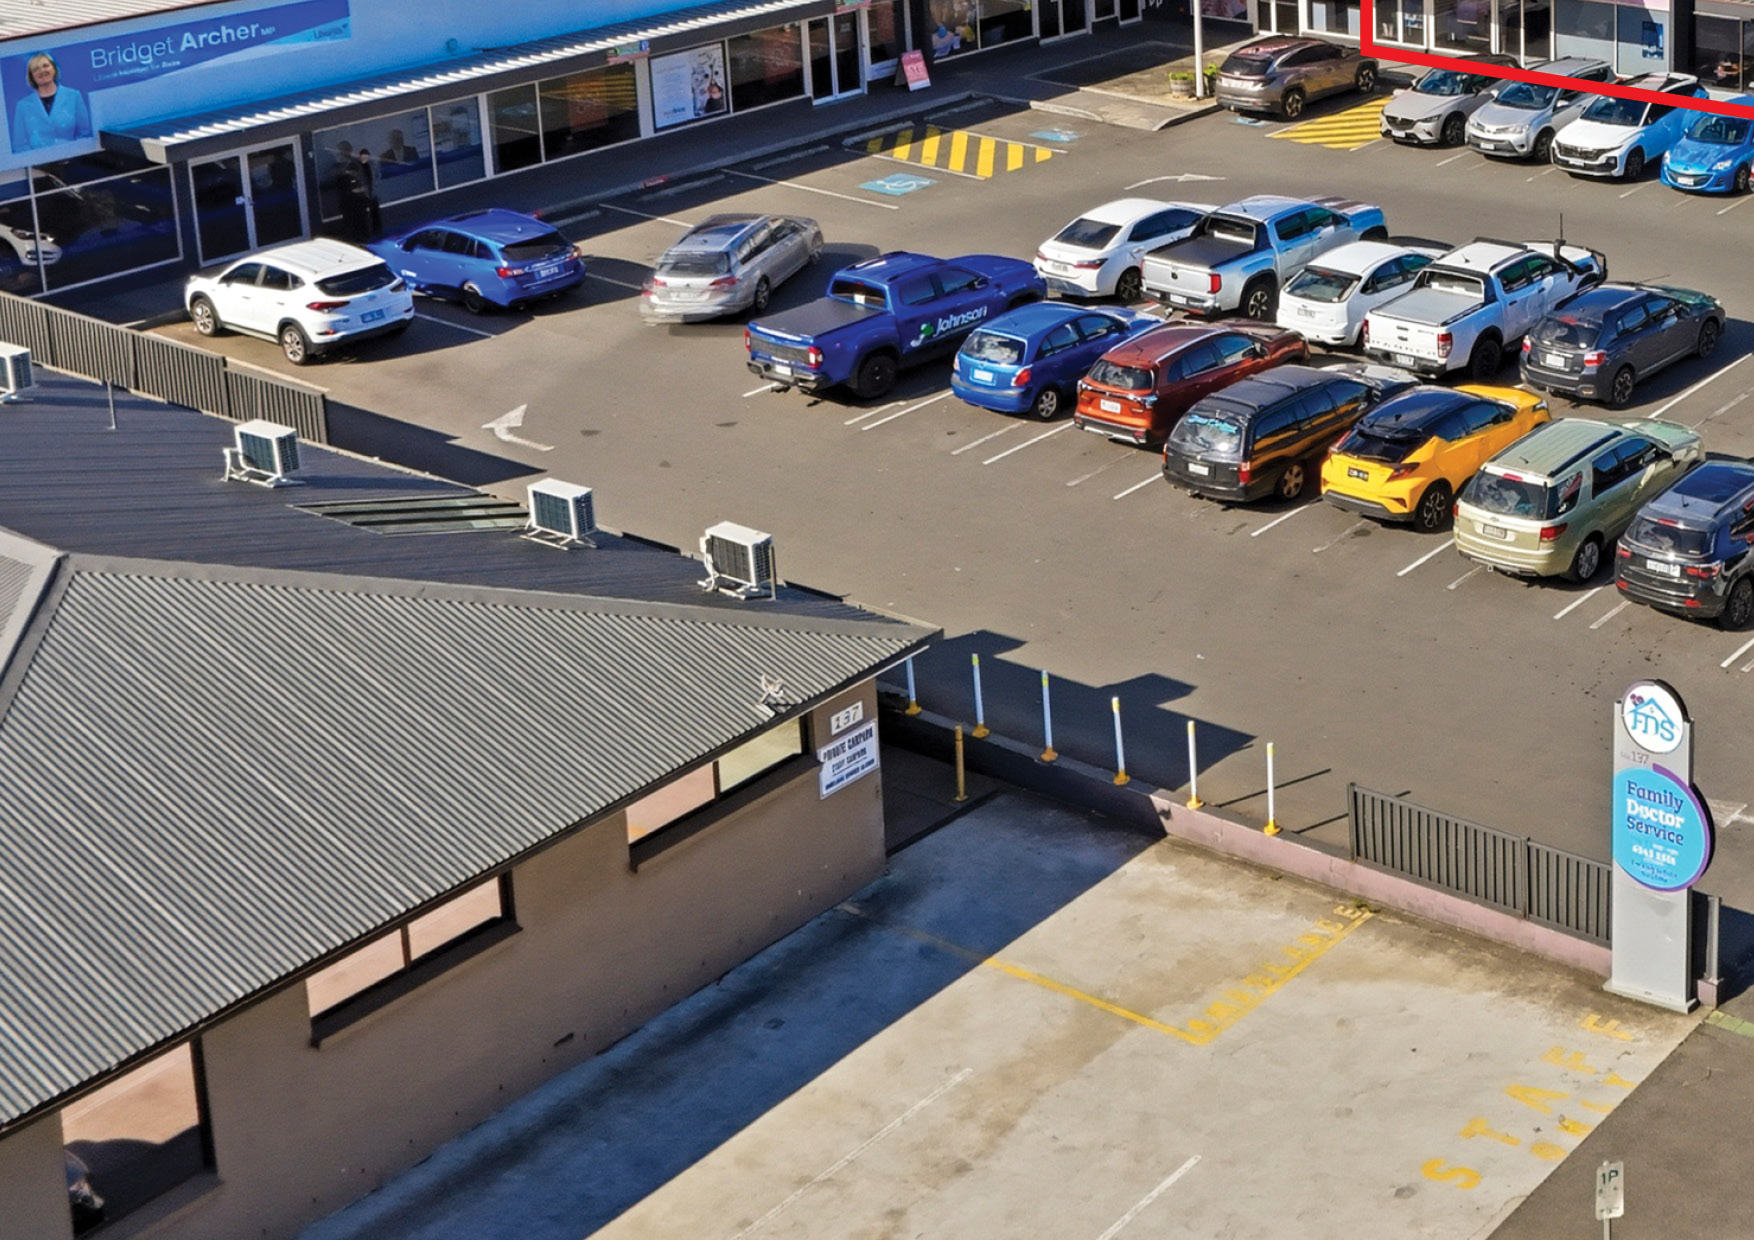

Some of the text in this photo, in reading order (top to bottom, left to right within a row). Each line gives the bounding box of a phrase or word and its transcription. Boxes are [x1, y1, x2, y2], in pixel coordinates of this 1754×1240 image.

[90, 36, 175, 69] Bridget
[179, 22, 260, 52] Archer
[933, 305, 987, 337] Johnson
[834, 705, 859, 730] 137
[1627, 780, 1683, 813] Family
[1626, 798, 1684, 828] Doctor
[1627, 815, 1683, 845] Service
[1602, 1169, 1618, 1185] 1P
